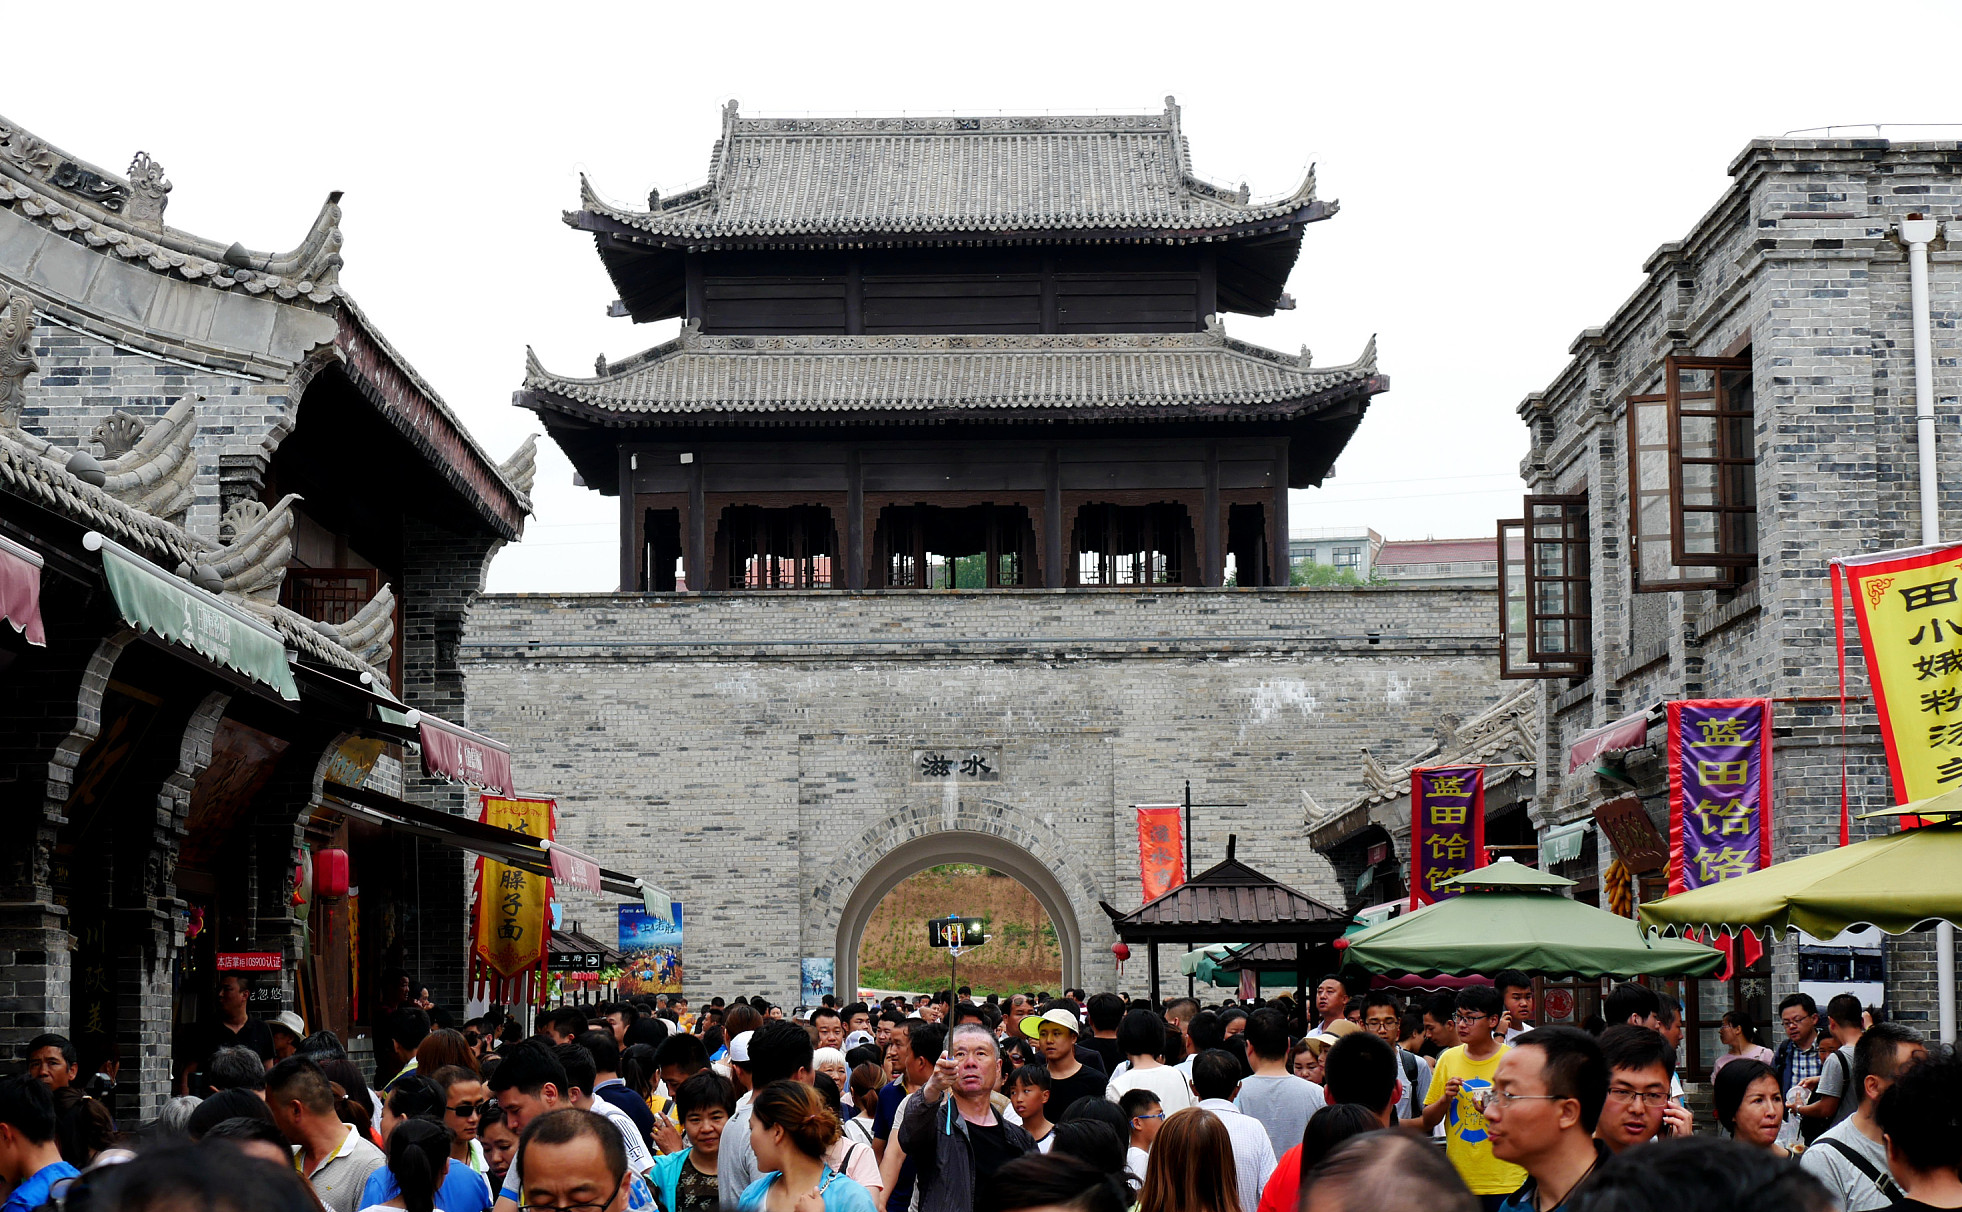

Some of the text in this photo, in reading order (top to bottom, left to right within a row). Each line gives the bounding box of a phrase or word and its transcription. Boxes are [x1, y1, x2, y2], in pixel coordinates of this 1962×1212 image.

[921, 754, 992, 777] 滋水
[1689, 717, 1756, 882] 蓝田饸饹
[497, 818, 530, 942] 臊子面
[1425, 776, 1473, 894] 蓝田饸饹
[1464, 1118, 1483, 1126] LIFE
